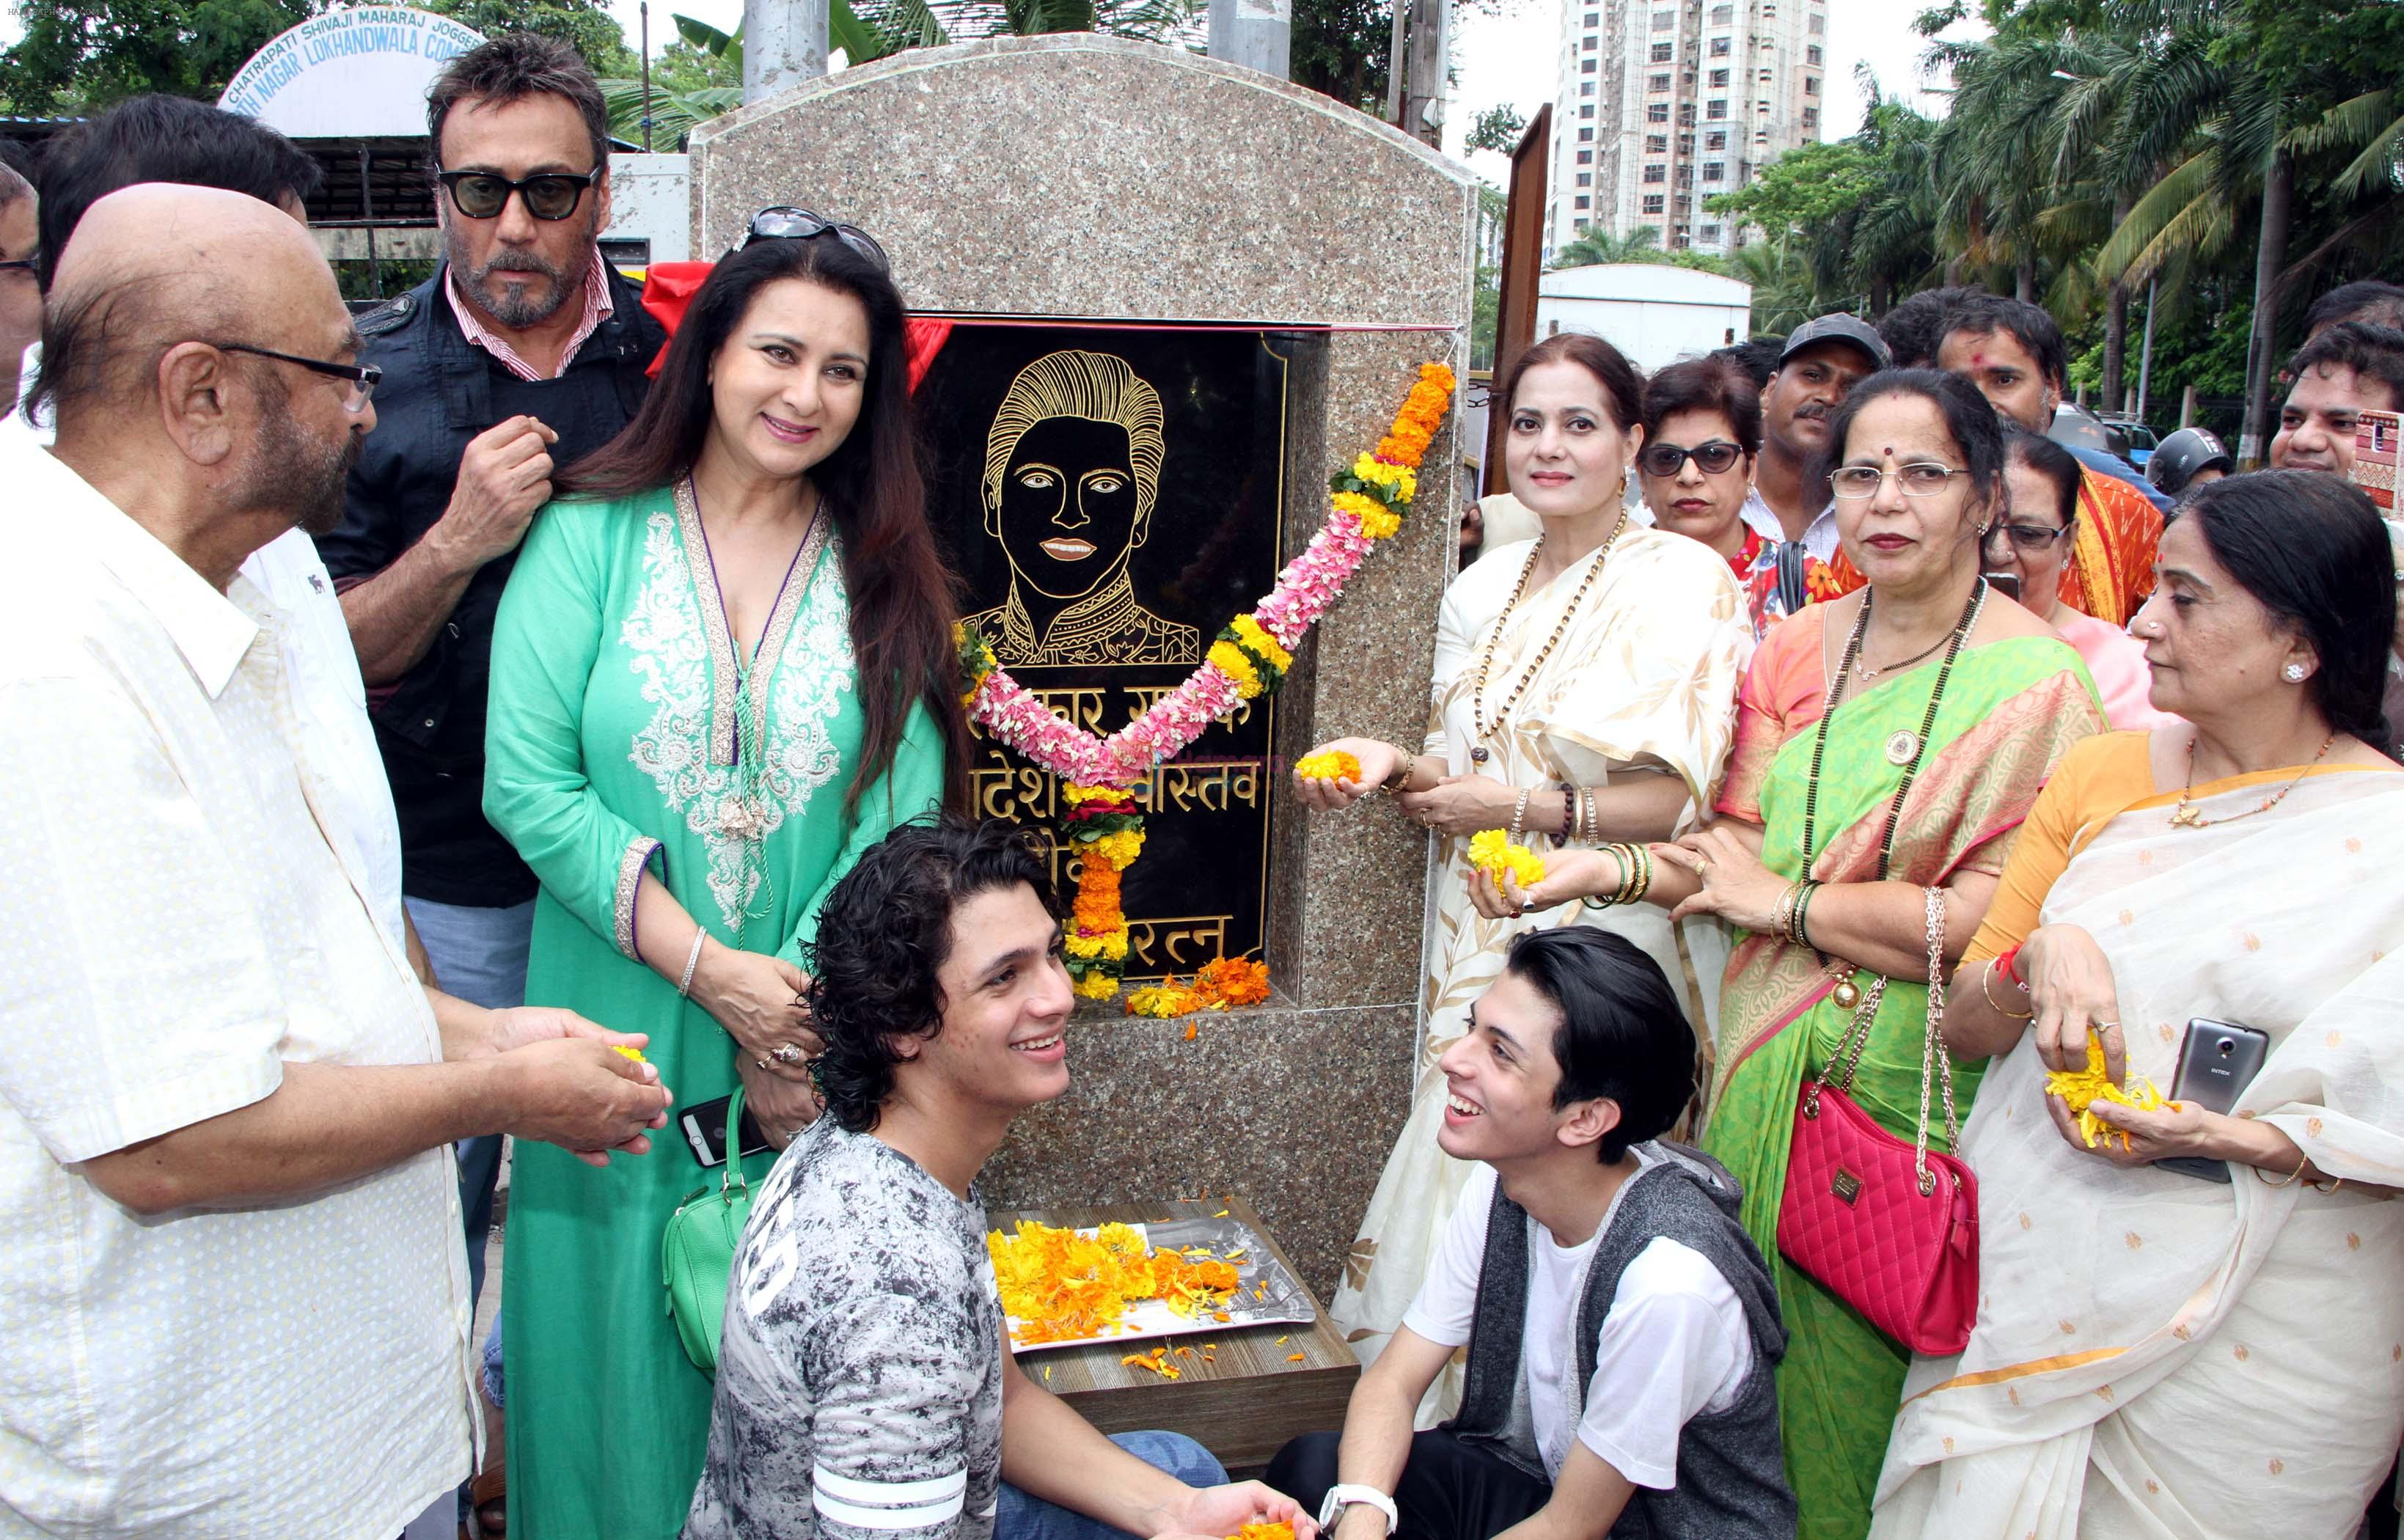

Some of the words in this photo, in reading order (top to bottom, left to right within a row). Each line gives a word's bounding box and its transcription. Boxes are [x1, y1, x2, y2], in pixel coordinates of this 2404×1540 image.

[228, 33, 297, 103] CHATRAPATI
[301, 13, 353, 40] SHIVAJI
[359, 10, 425, 28] MAHARAJ
[432, 21, 480, 51] JOGGER
[254, 52, 303, 103] NAGAR
[304, 26, 418, 66] LOKHANDWALA
[425, 34, 460, 62] COM
